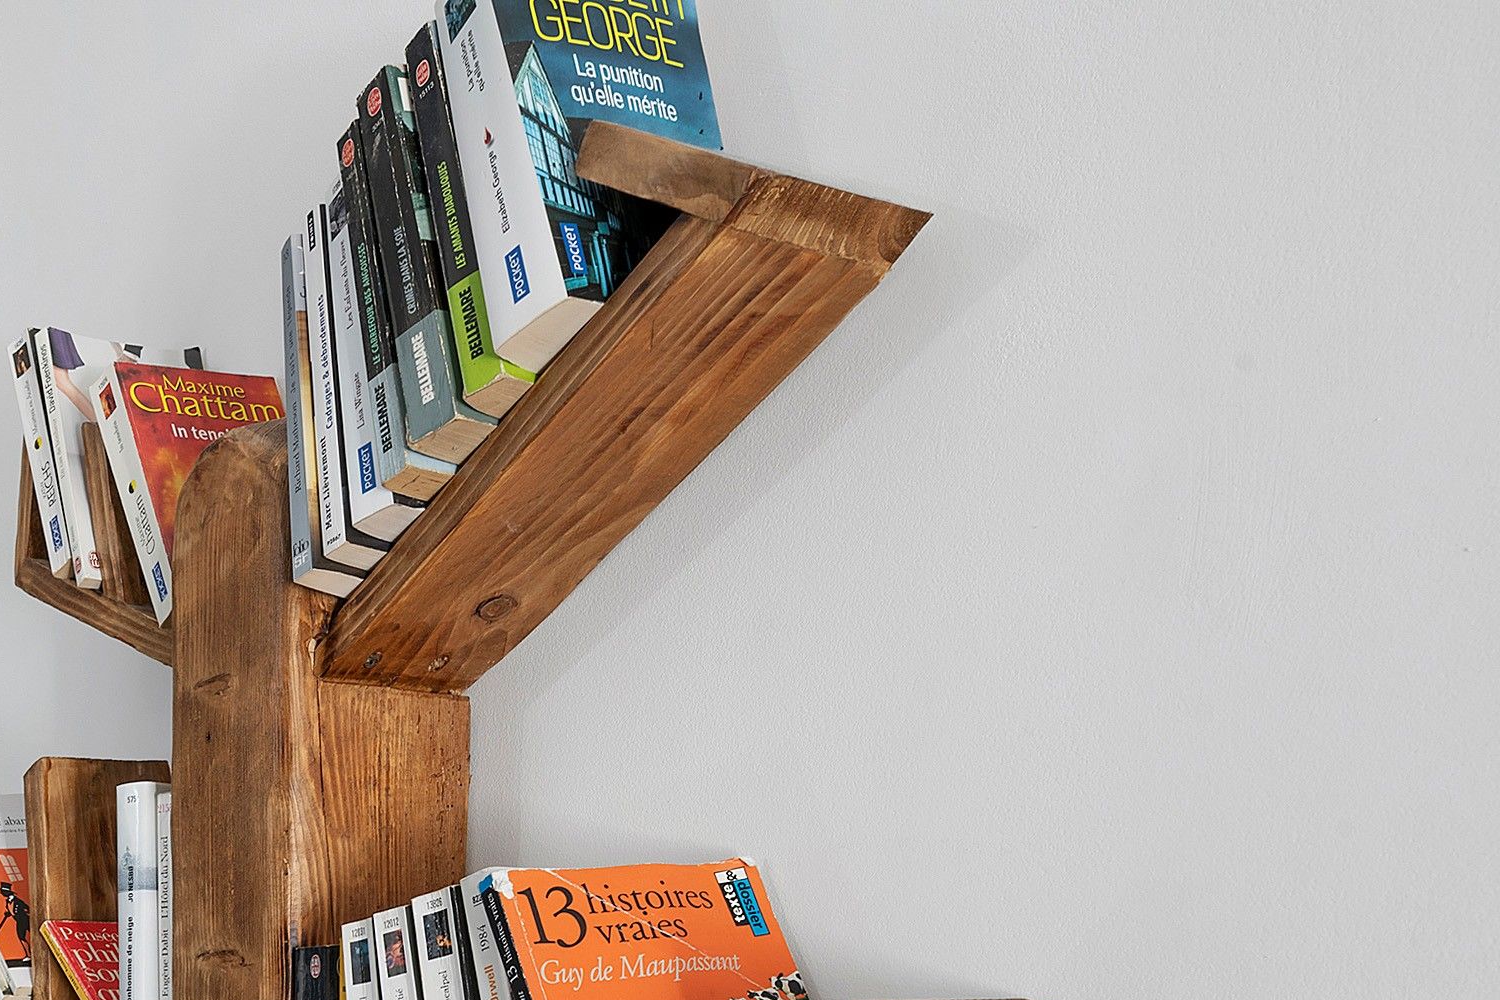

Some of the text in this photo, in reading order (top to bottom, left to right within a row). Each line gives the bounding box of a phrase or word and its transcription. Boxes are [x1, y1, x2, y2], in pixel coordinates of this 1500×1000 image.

[528, 0, 684, 68] GEORGE
[573, 53, 664, 93] La punition
[571, 82, 678, 122] qu'elle mérite
[490, 151, 510, 233] Elizabeth George
[394, 226, 404, 246] SOIE
[436, 161, 466, 268] LES AMANTS DIABOLIQUES
[358, 243, 370, 287] ANGOISSES
[398, 256, 412, 282] DANS
[561, 225, 585, 272] POCKET
[505, 251, 526, 298] POCKET
[364, 288, 372, 305] DES
[402, 278, 418, 315] CRIMES
[318, 295, 328, 368] débordements
[365, 301, 378, 355] CARREFOUR
[459, 285, 484, 361] BELLEMARE
[41, 344, 55, 414] David Foenkinos
[162, 374, 246, 399] Maxime
[411, 330, 435, 406] BELLEMARE
[129, 381, 280, 423] Chattam
[374, 382, 392, 455] BELLEMARE
[171, 423, 188, 438] In
[42, 461, 56, 507] REICHS
[293, 452, 301, 493] Richard
[517, 878, 714, 948] 13 histoires
[723, 884, 746, 922] texte
[737, 882, 763, 928] dossier
[60, 926, 119, 941] Pensée
[127, 945, 132, 955] de
[477, 925, 489, 951] 1984
[593, 915, 689, 943] vraies
[539, 952, 741, 991] Guy de Maupassant
